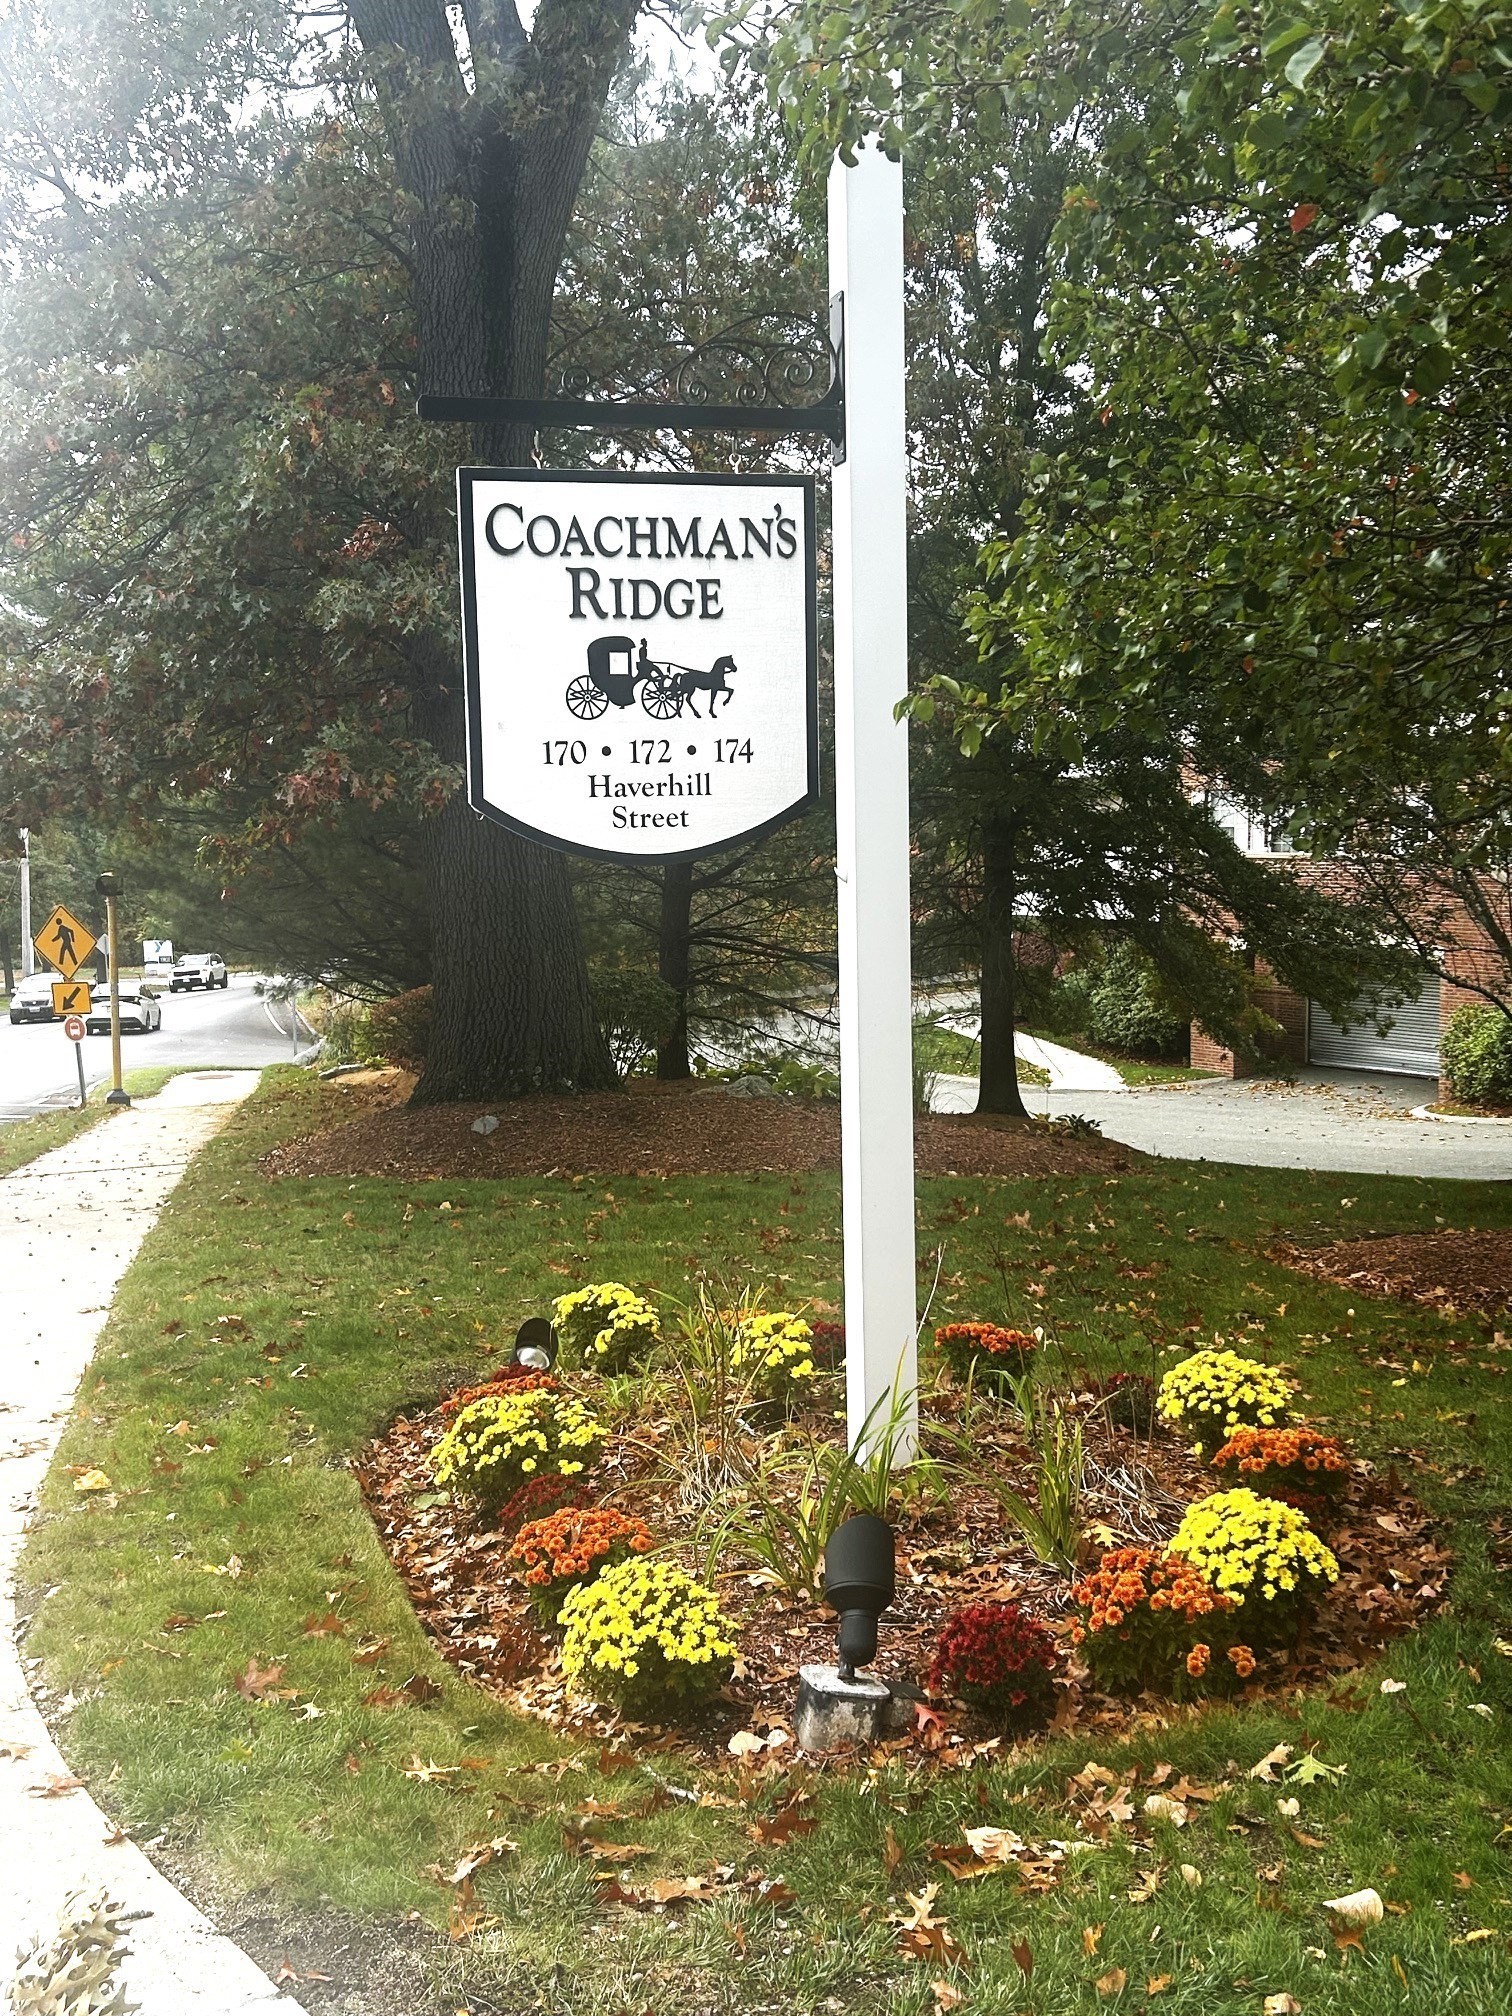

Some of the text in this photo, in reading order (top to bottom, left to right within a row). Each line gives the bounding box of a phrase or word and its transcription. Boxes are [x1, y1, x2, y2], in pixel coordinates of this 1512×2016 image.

[485, 502, 797, 560] COACHMAN'S
[565, 566, 724, 620] RIDGE
[542, 737, 754, 766] 170 172 174
[588, 772, 712, 798] Haverhill
[612, 805, 690, 829] Street
